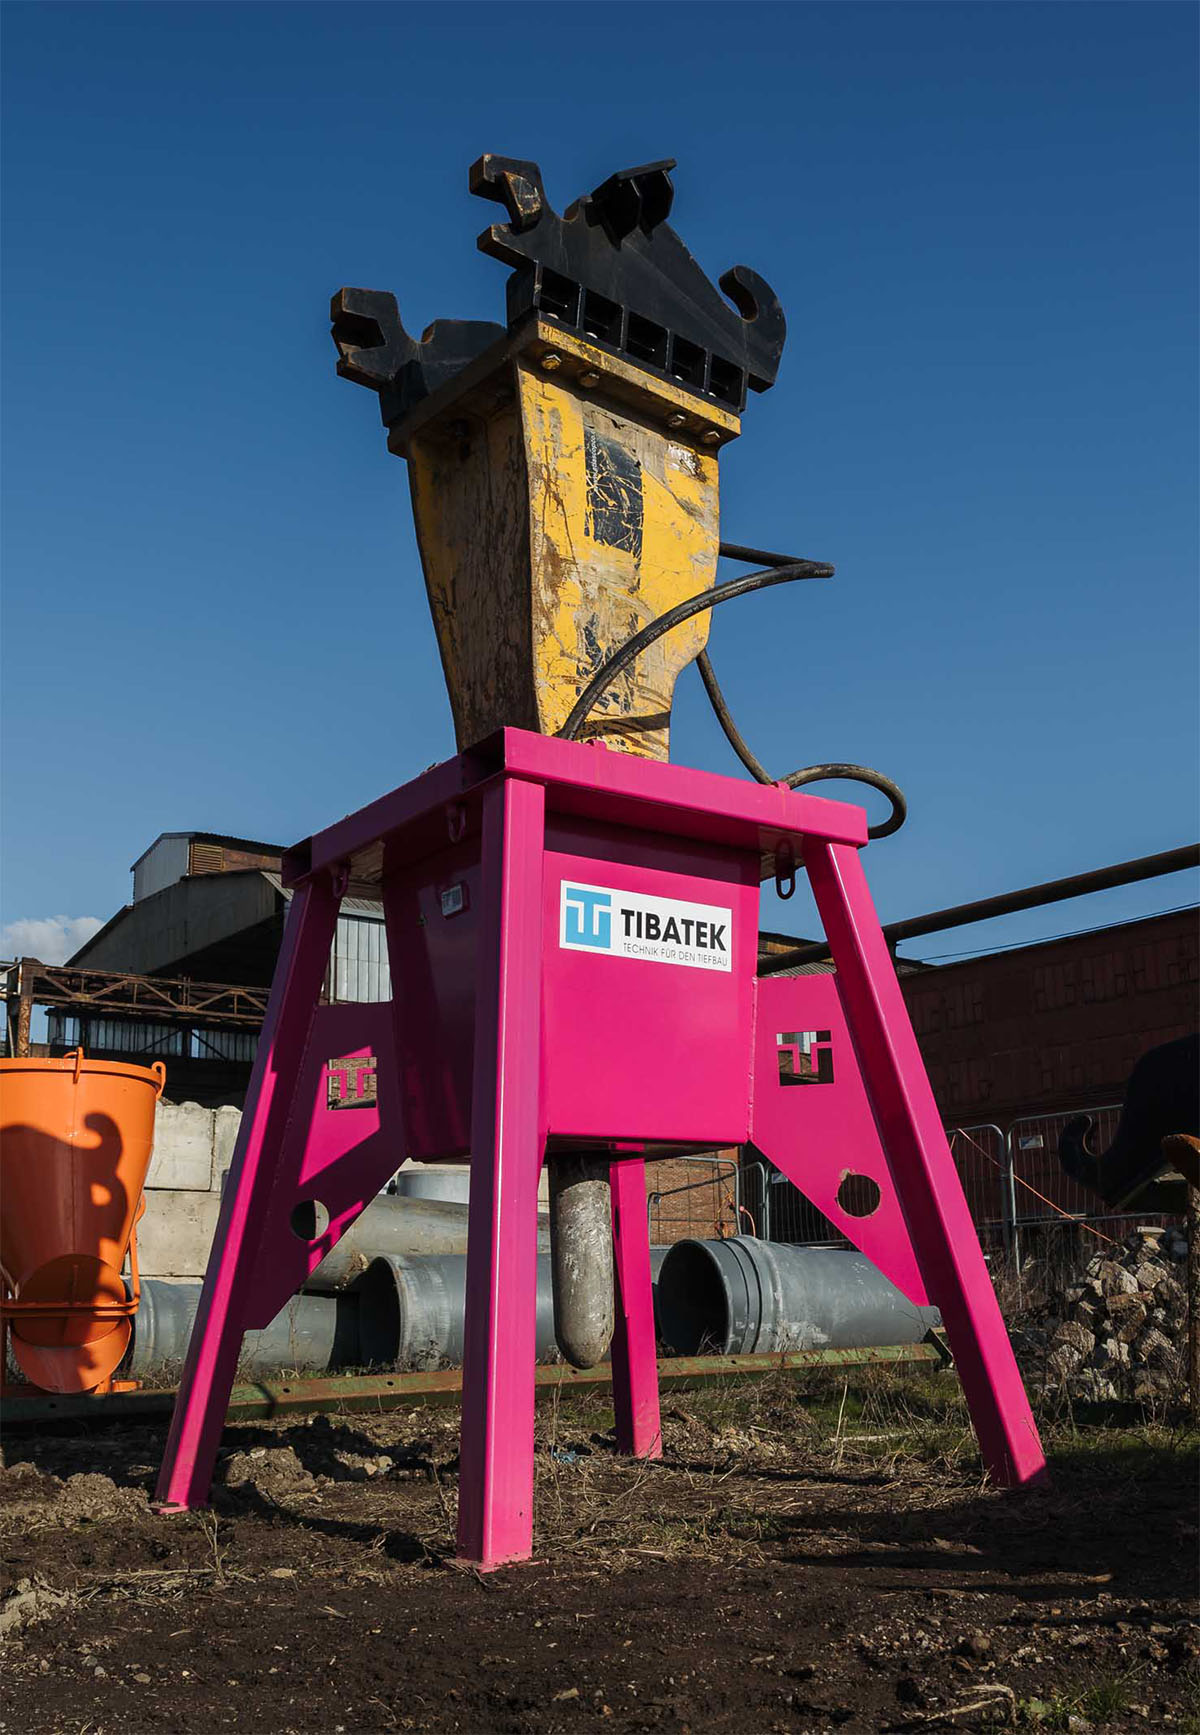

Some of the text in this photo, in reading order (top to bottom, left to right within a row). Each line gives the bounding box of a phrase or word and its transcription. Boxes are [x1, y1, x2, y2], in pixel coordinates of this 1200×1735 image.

[620, 909, 726, 951] TIBATEK
[623, 942, 728, 967] TECHNIK FÜR DEN TIEFBAU
